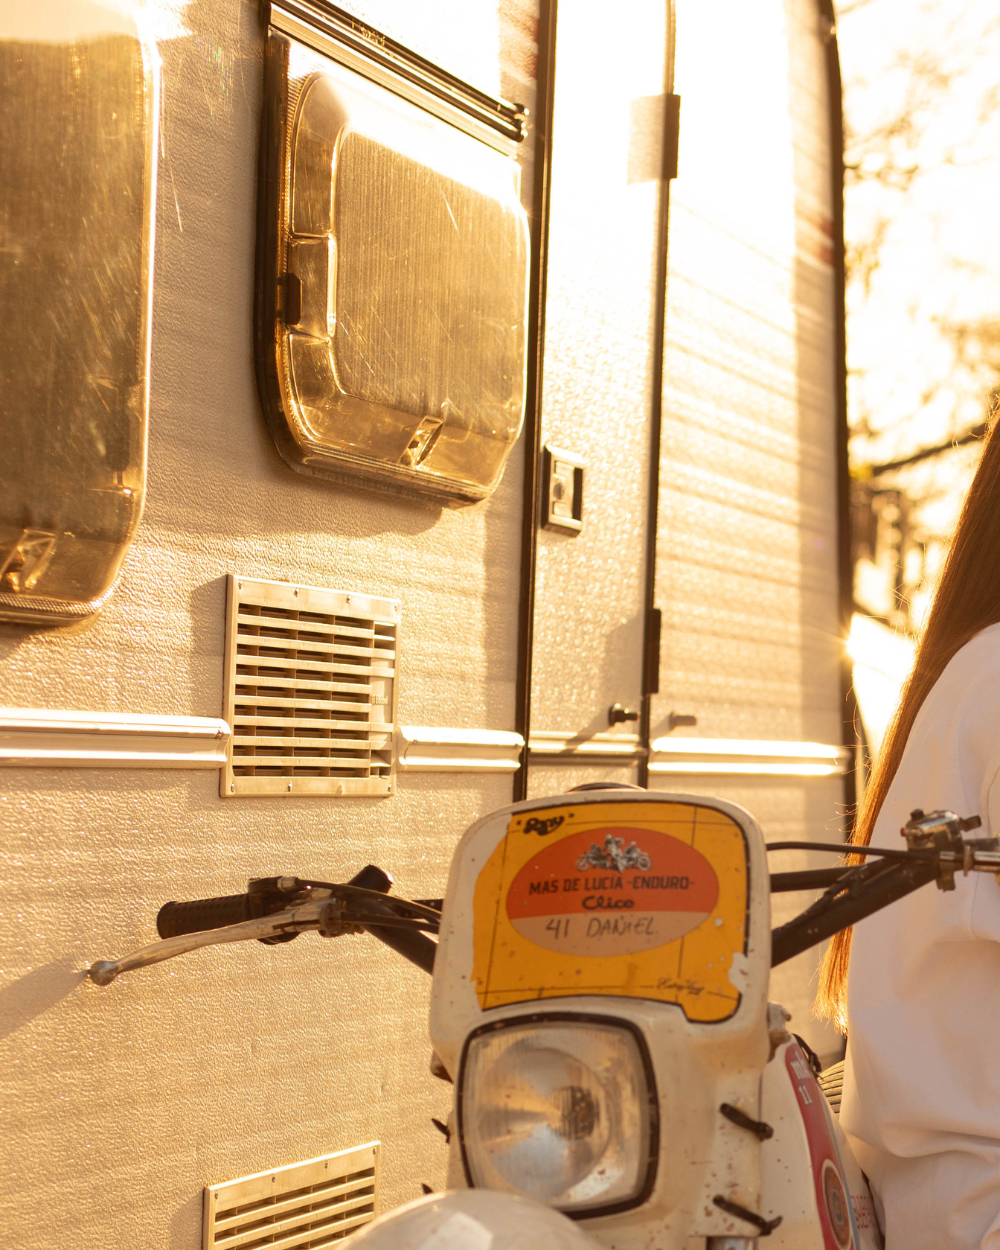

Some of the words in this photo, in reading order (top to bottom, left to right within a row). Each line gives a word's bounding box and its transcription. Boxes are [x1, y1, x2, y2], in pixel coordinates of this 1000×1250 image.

[529, 880, 559, 895] MAS
[563, 878, 580, 892] DE
[584, 876, 623, 890] LUCIA
[545, 917, 570, 940] 41
